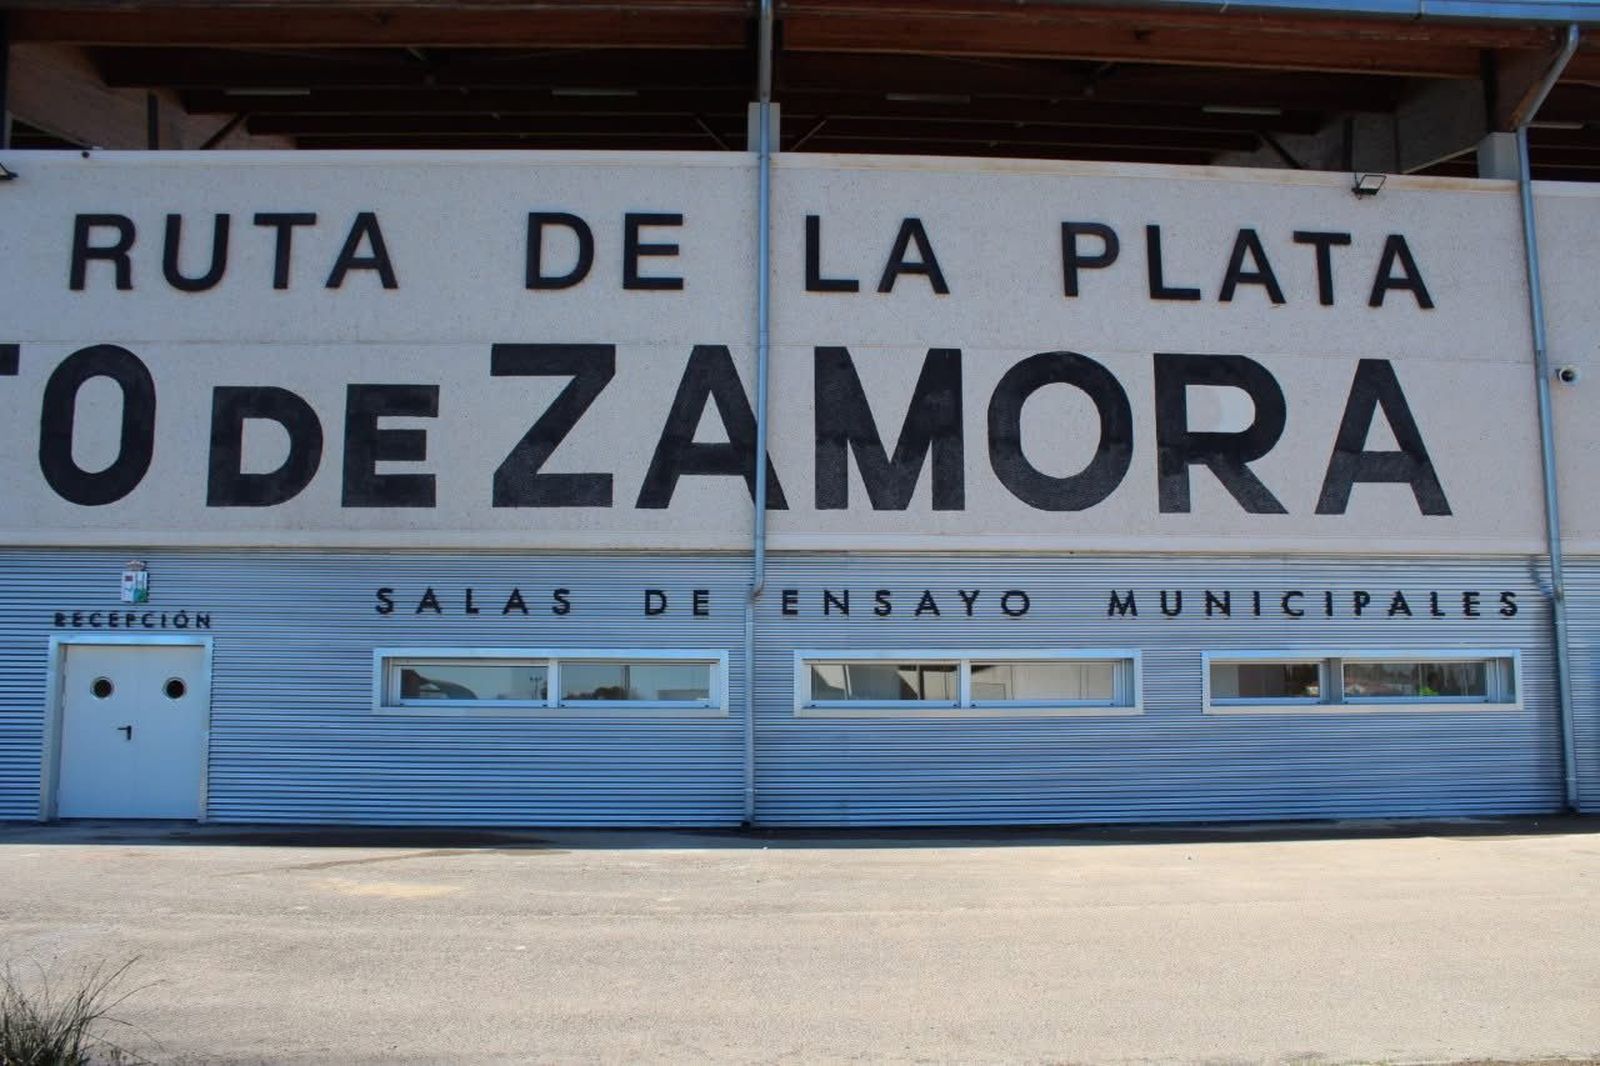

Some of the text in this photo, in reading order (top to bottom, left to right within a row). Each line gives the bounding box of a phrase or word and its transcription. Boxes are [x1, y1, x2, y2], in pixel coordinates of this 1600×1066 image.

[68, 212, 1434, 309] RUTA DE LA PLATA
[0, 343, 1452, 516] O DE ZAMORA
[54, 610, 211, 629] RECEPCIÓN
[375, 587, 1519, 617] SALAS DE ENSAYO MUNICIPALES
